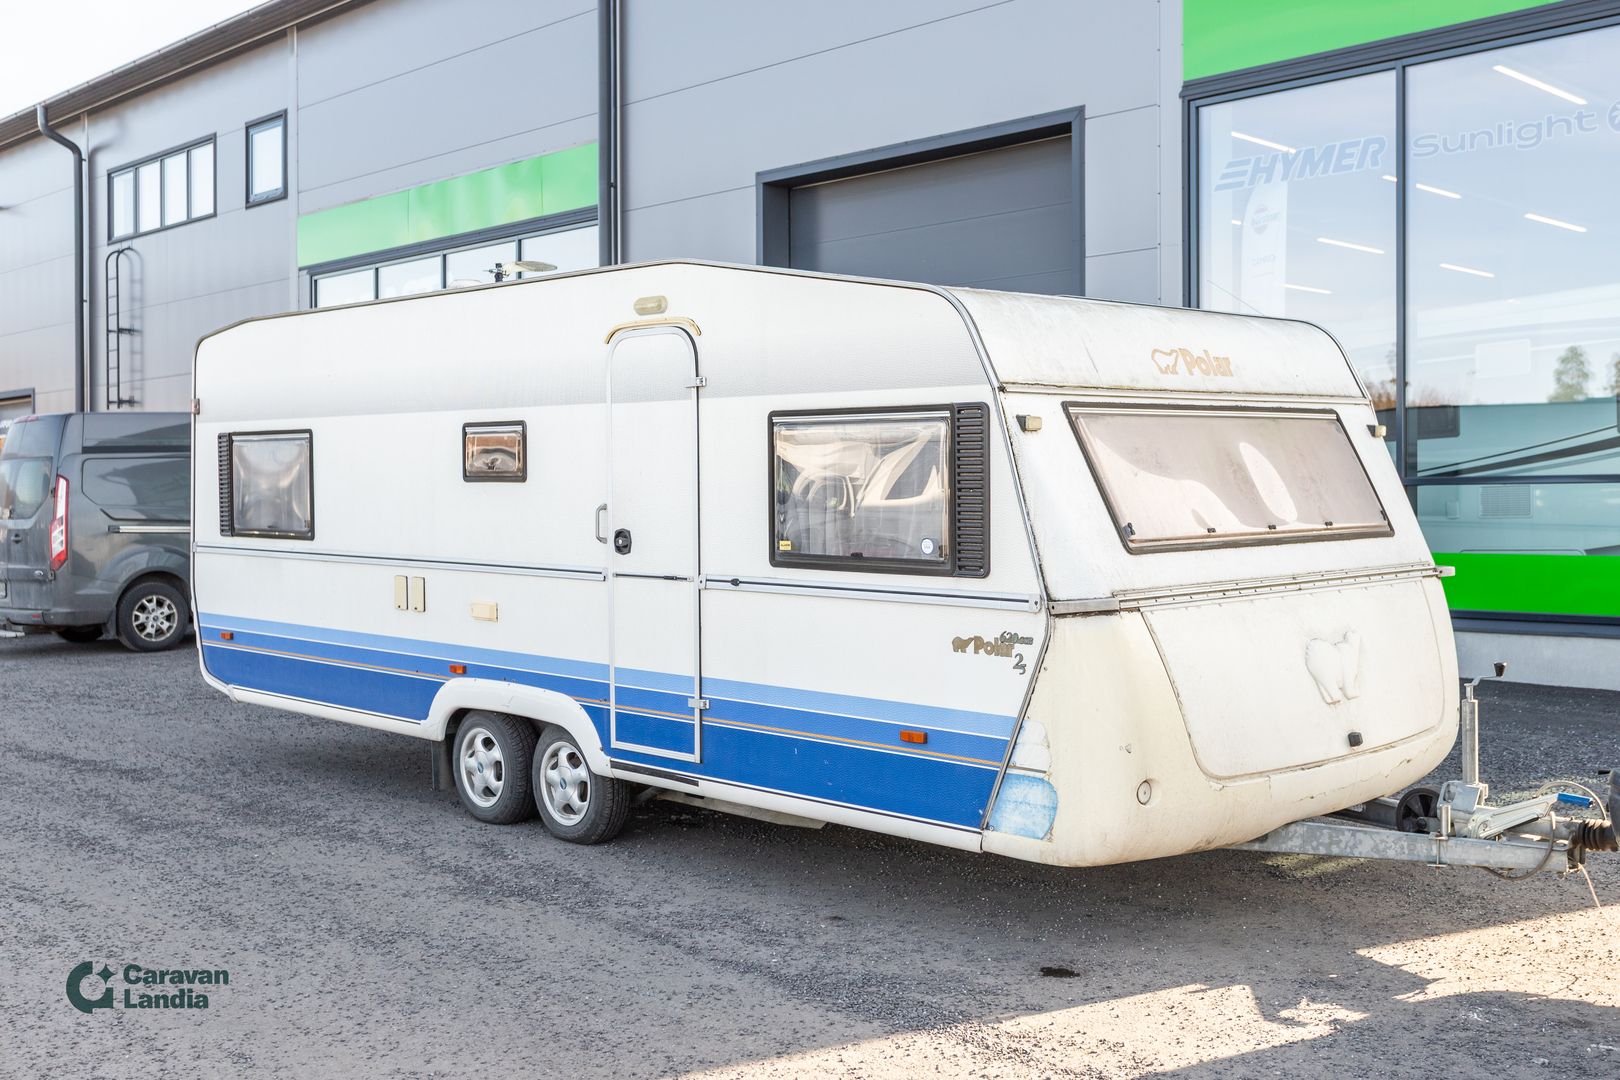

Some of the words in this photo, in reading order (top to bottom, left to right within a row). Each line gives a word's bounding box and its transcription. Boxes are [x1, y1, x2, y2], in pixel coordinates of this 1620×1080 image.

[1411, 109, 1598, 159] Sunlight
[1246, 135, 1388, 188] HYMER
[1178, 347, 1233, 377] Polar
[973, 635, 1014, 657] Polar
